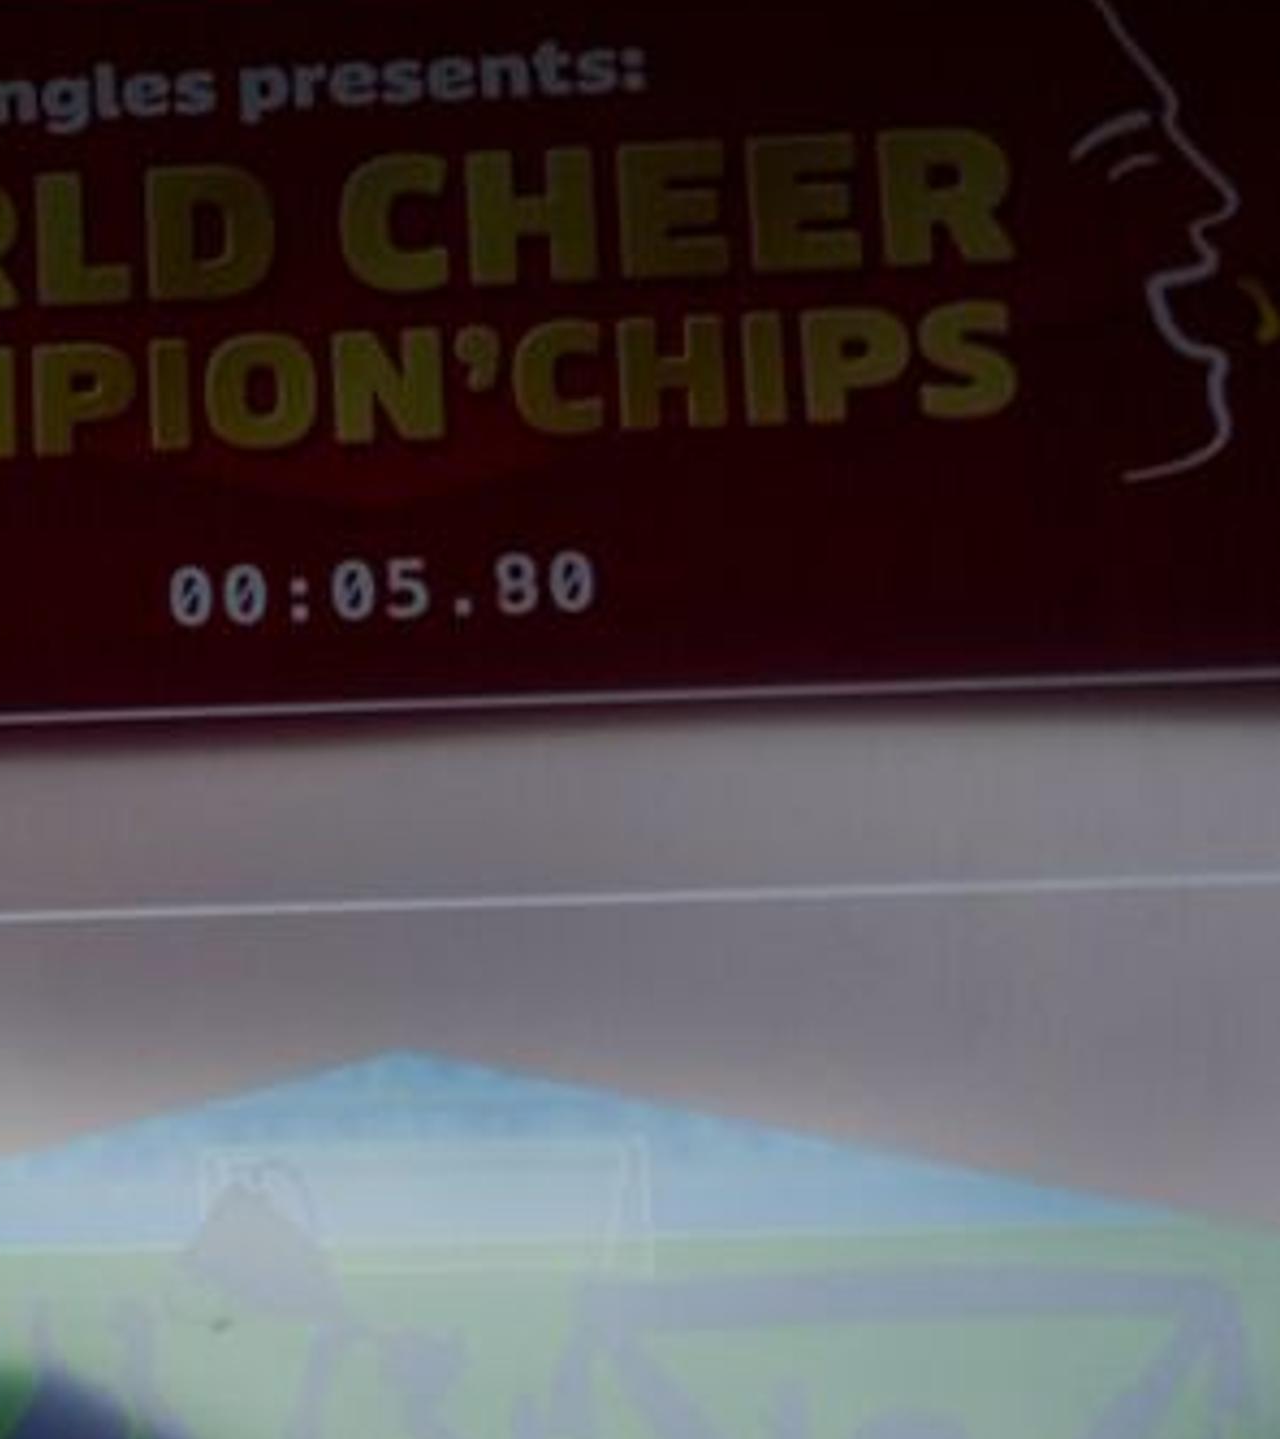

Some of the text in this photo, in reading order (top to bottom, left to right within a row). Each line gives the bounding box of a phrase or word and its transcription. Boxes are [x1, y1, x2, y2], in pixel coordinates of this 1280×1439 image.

[237, 40, 648, 122] presents:
[338, 127, 1016, 292] CHEER
[168, 550, 594, 628] 00:05.80
